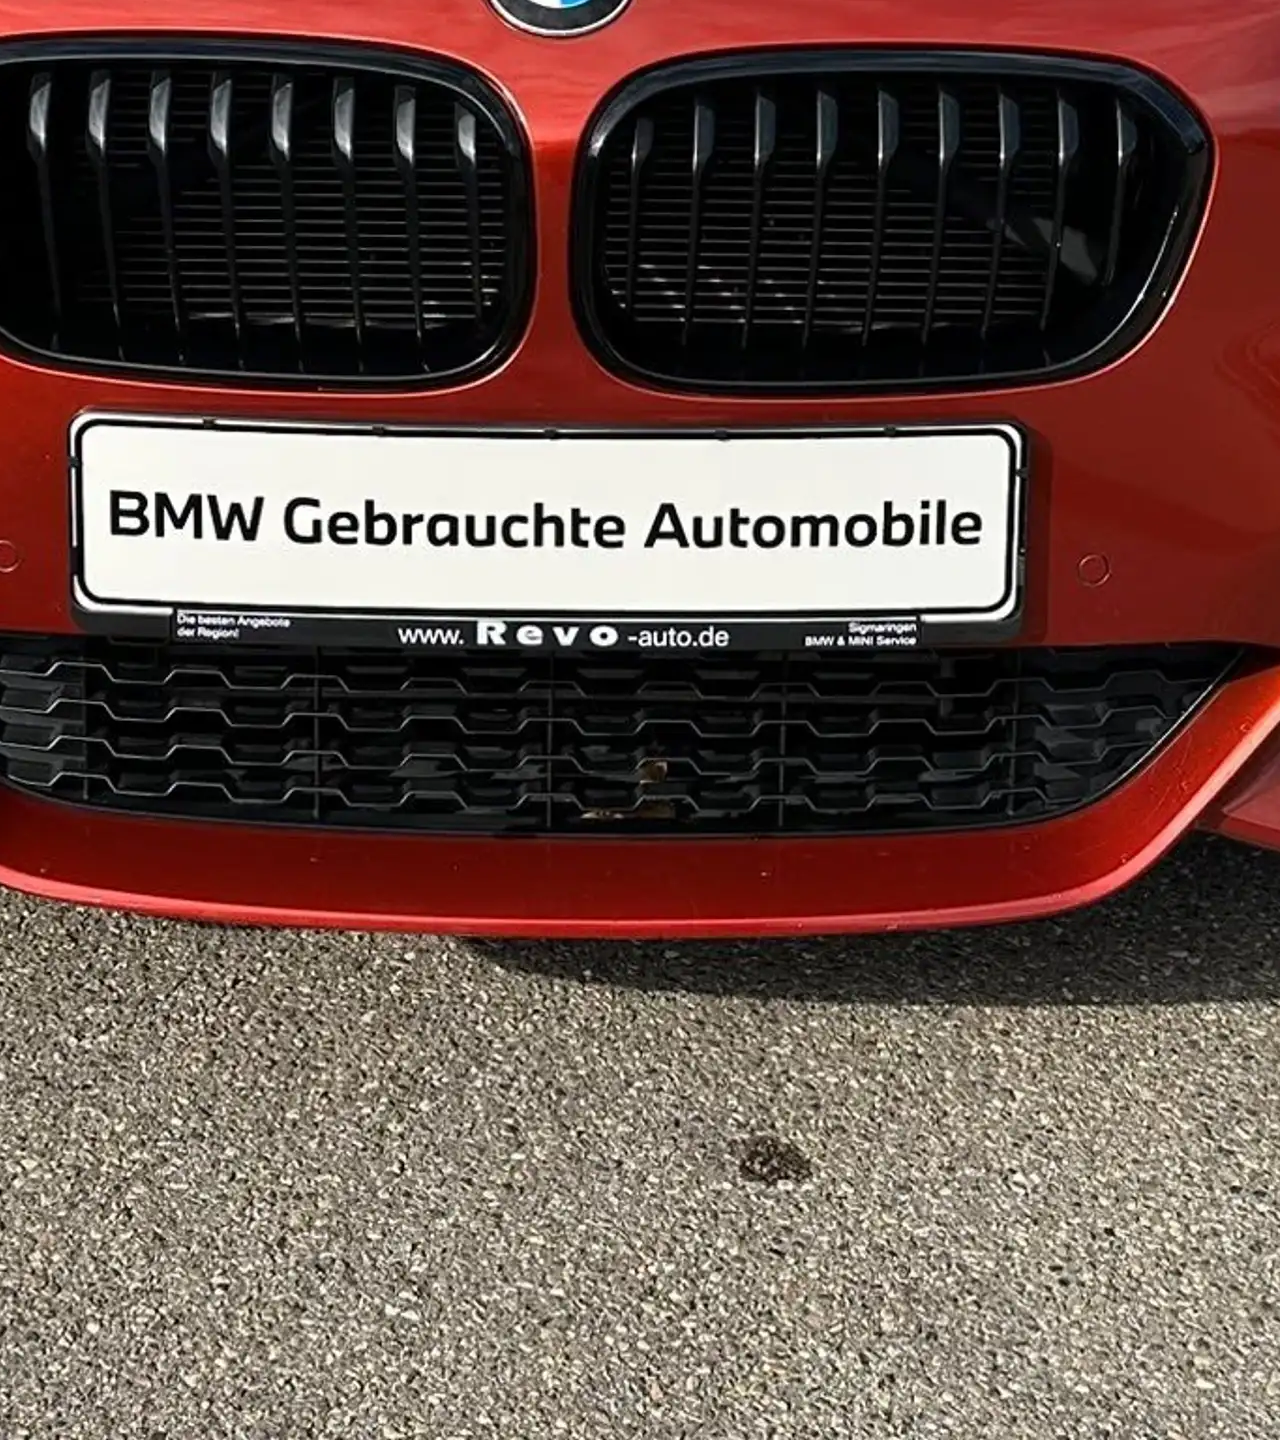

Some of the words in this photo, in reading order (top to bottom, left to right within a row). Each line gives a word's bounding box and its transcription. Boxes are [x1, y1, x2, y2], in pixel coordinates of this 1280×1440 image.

[109, 490, 264, 541] BMW
[284, 497, 626, 548] Gebrauchte
[644, 499, 983, 548] Automobile
[177, 612, 196, 625] Die
[198, 614, 235, 626] besten
[237, 616, 291, 629] Angebote
[177, 626, 195, 637] der
[398, 627, 464, 645] www.
[476, 621, 619, 646] Revo
[848, 622, 917, 635] Sigmaringen
[805, 636, 834, 646] BMW
[837, 636, 845, 646] &
[848, 636, 873, 646] MINI
[877, 635, 917, 646] Service
